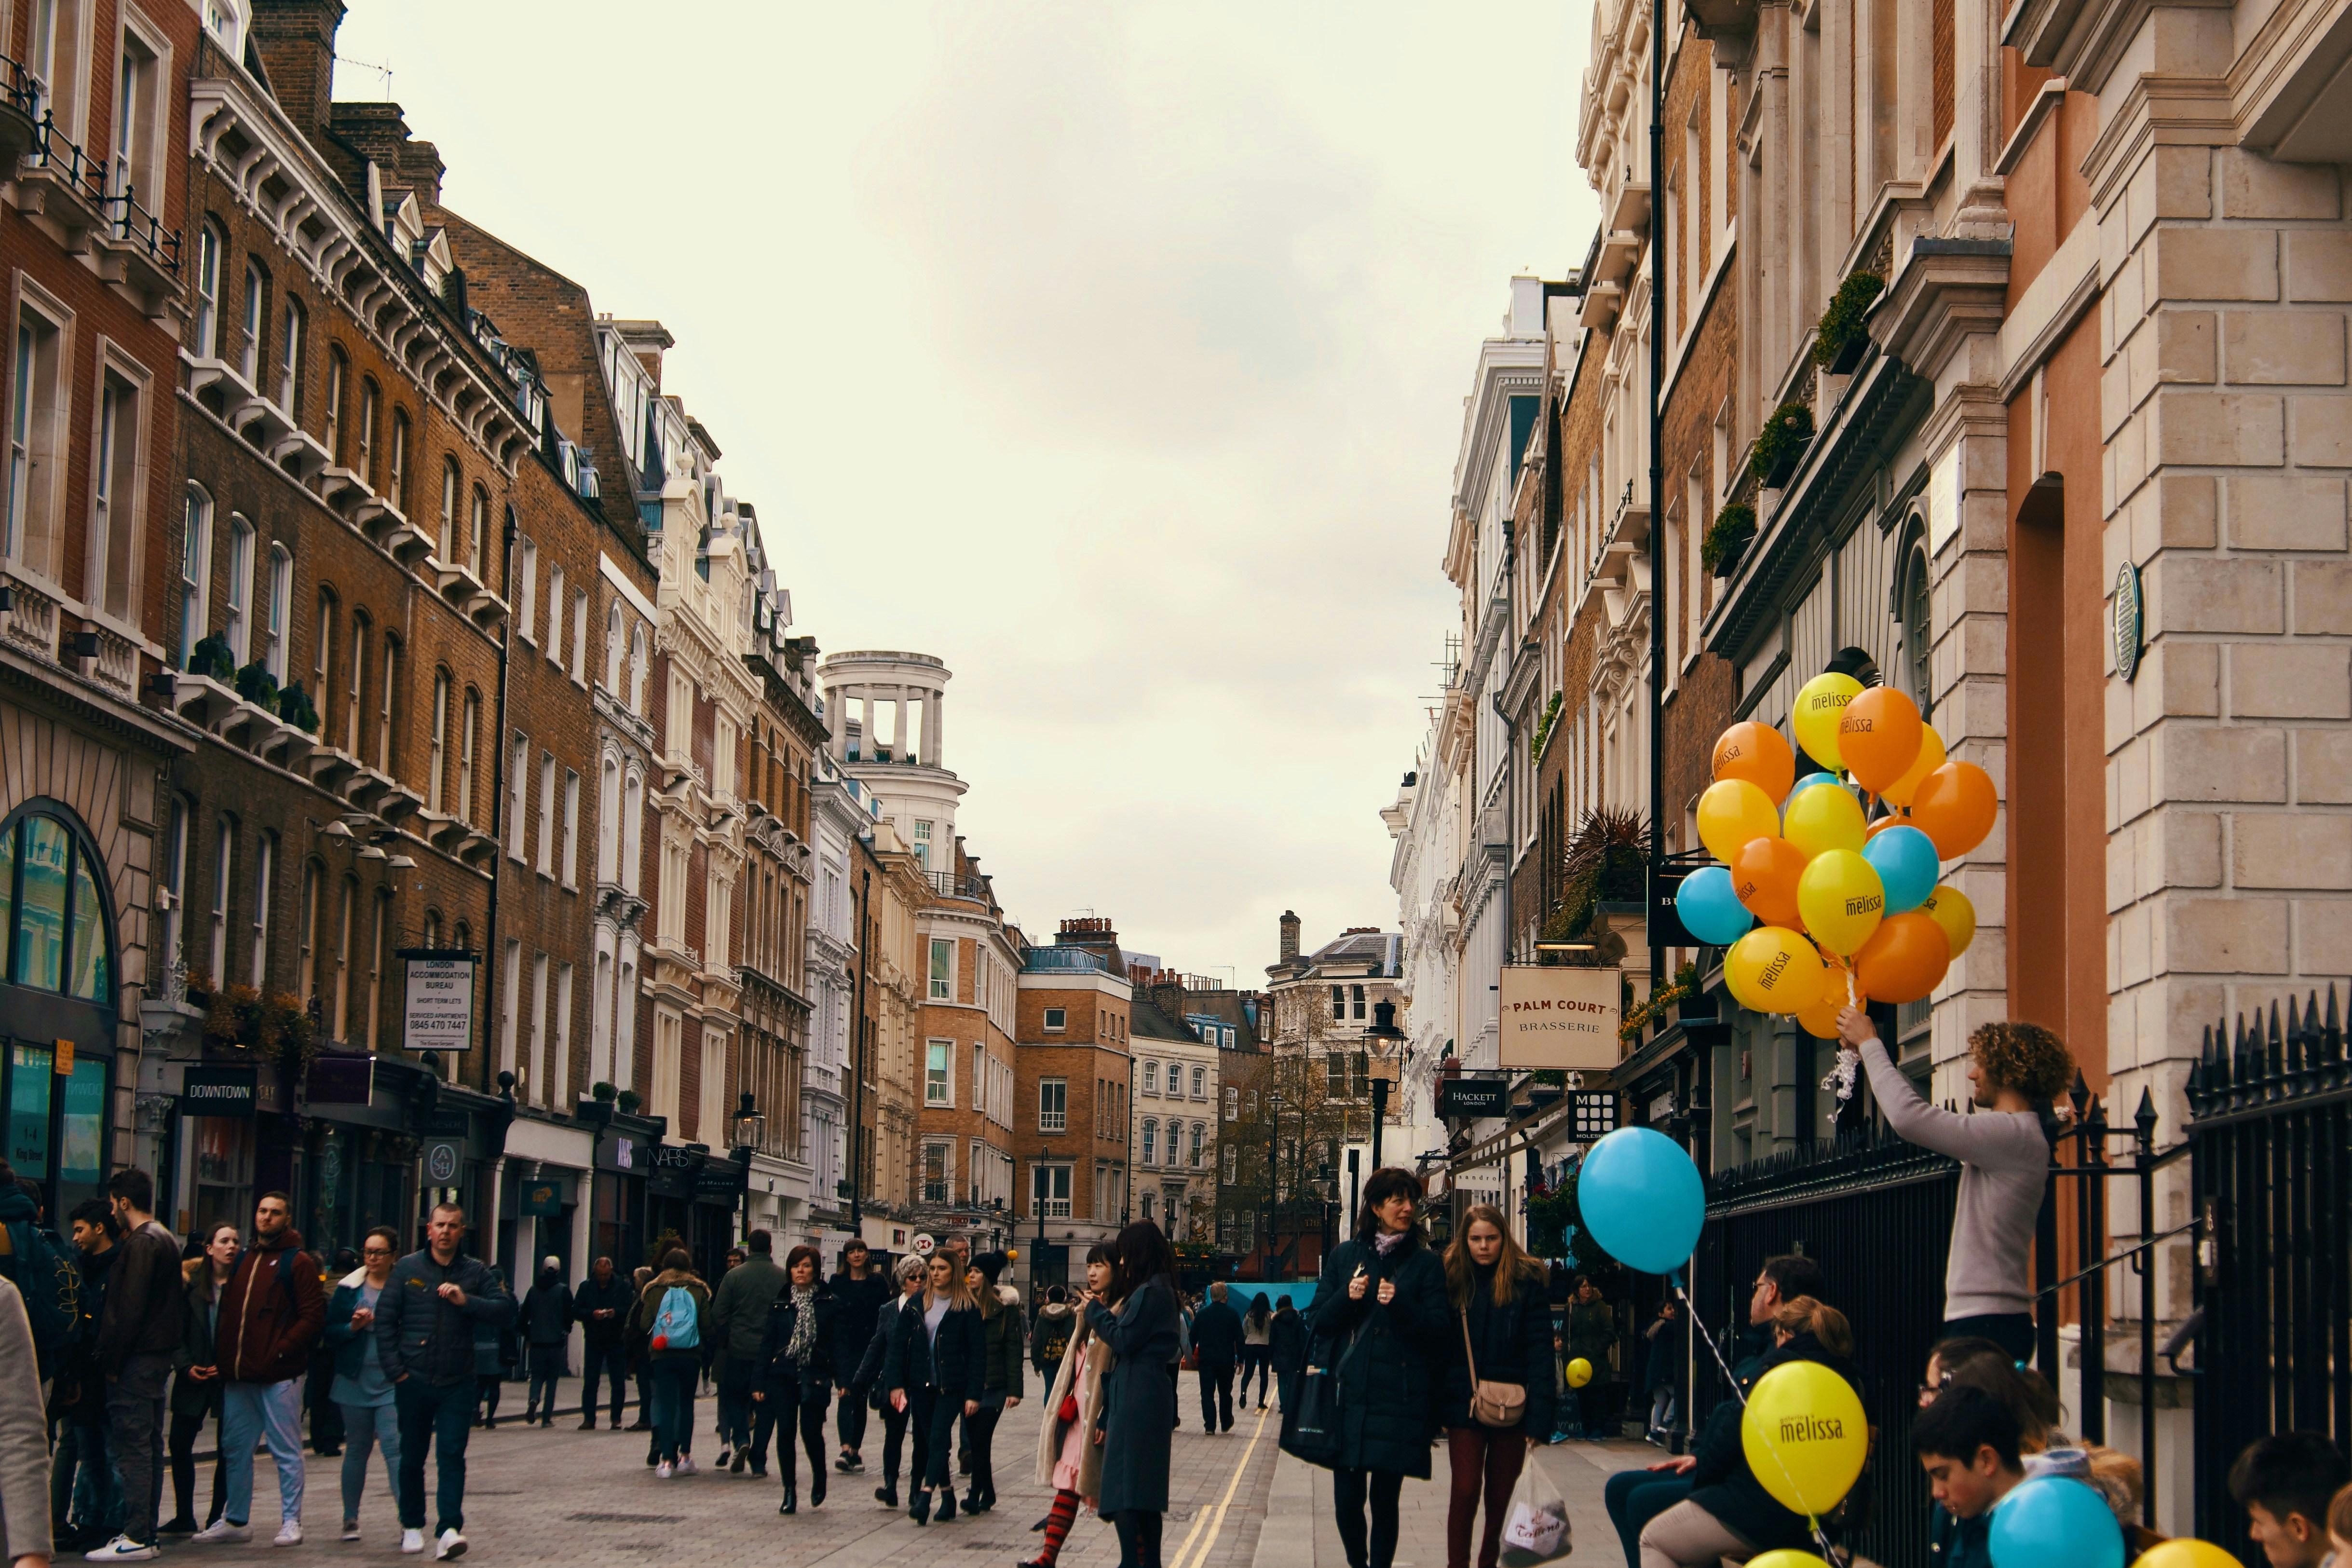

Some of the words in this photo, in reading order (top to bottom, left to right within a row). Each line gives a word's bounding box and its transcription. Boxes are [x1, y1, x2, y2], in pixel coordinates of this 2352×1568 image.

[1840, 716, 1872, 735] melissa
[1847, 895, 1881, 916] melissa
[410, 971, 470, 979] ACCOMMODATION
[1761, 952, 1791, 991] melissa
[1513, 1000, 1551, 1012] PALM
[1557, 1000, 1606, 1014] COURT
[410, 1021, 429, 1029] 0845
[431, 1021, 445, 1029] 470
[447, 1021, 466, 1030] 7447
[1520, 1022, 1600, 1033] BRASSERIE
[190, 1085, 250, 1098] DOWNTOWN
[1453, 1092, 1496, 1101] HACKETT
[16, 1148, 28, 1163] King
[28, 1149, 43, 1162] Street
[647, 1148, 689, 1167] NARS
[1781, 1415, 1842, 1444] melissa
